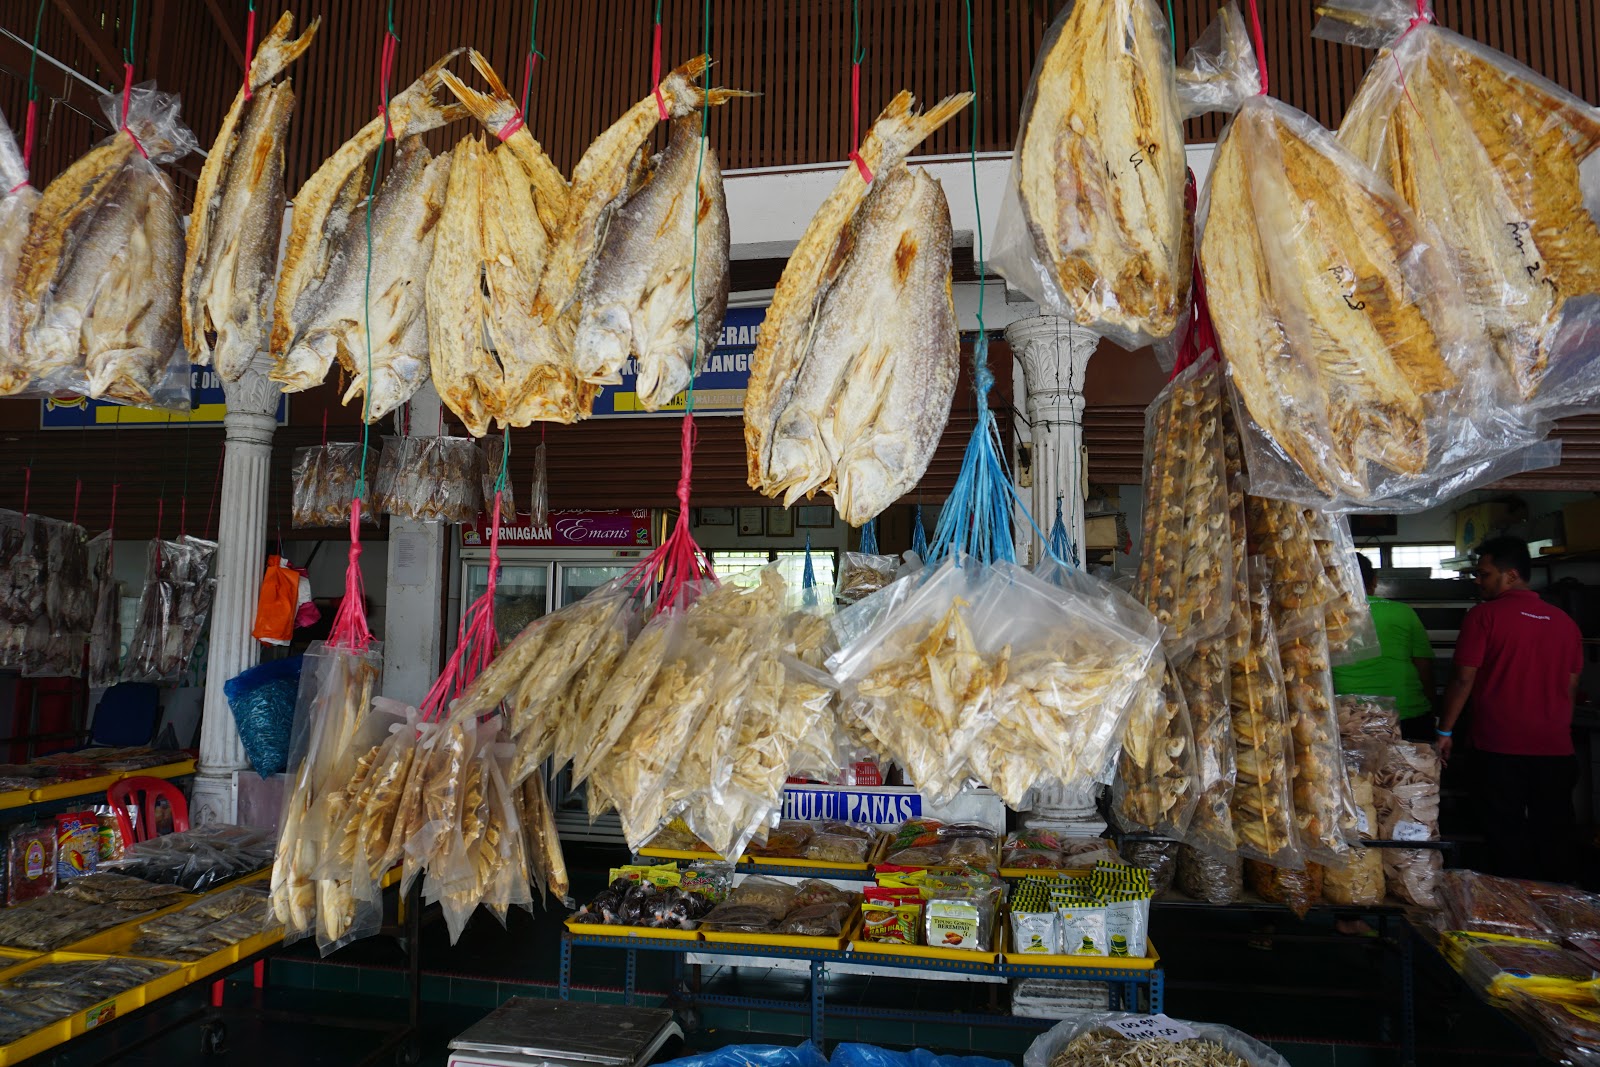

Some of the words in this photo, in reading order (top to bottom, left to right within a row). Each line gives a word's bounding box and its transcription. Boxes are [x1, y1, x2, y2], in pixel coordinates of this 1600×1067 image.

[485, 526, 552, 541] PRNIAGAAN
[555, 518, 630, 542] Emanis
[846, 793, 913, 824] PANAS
